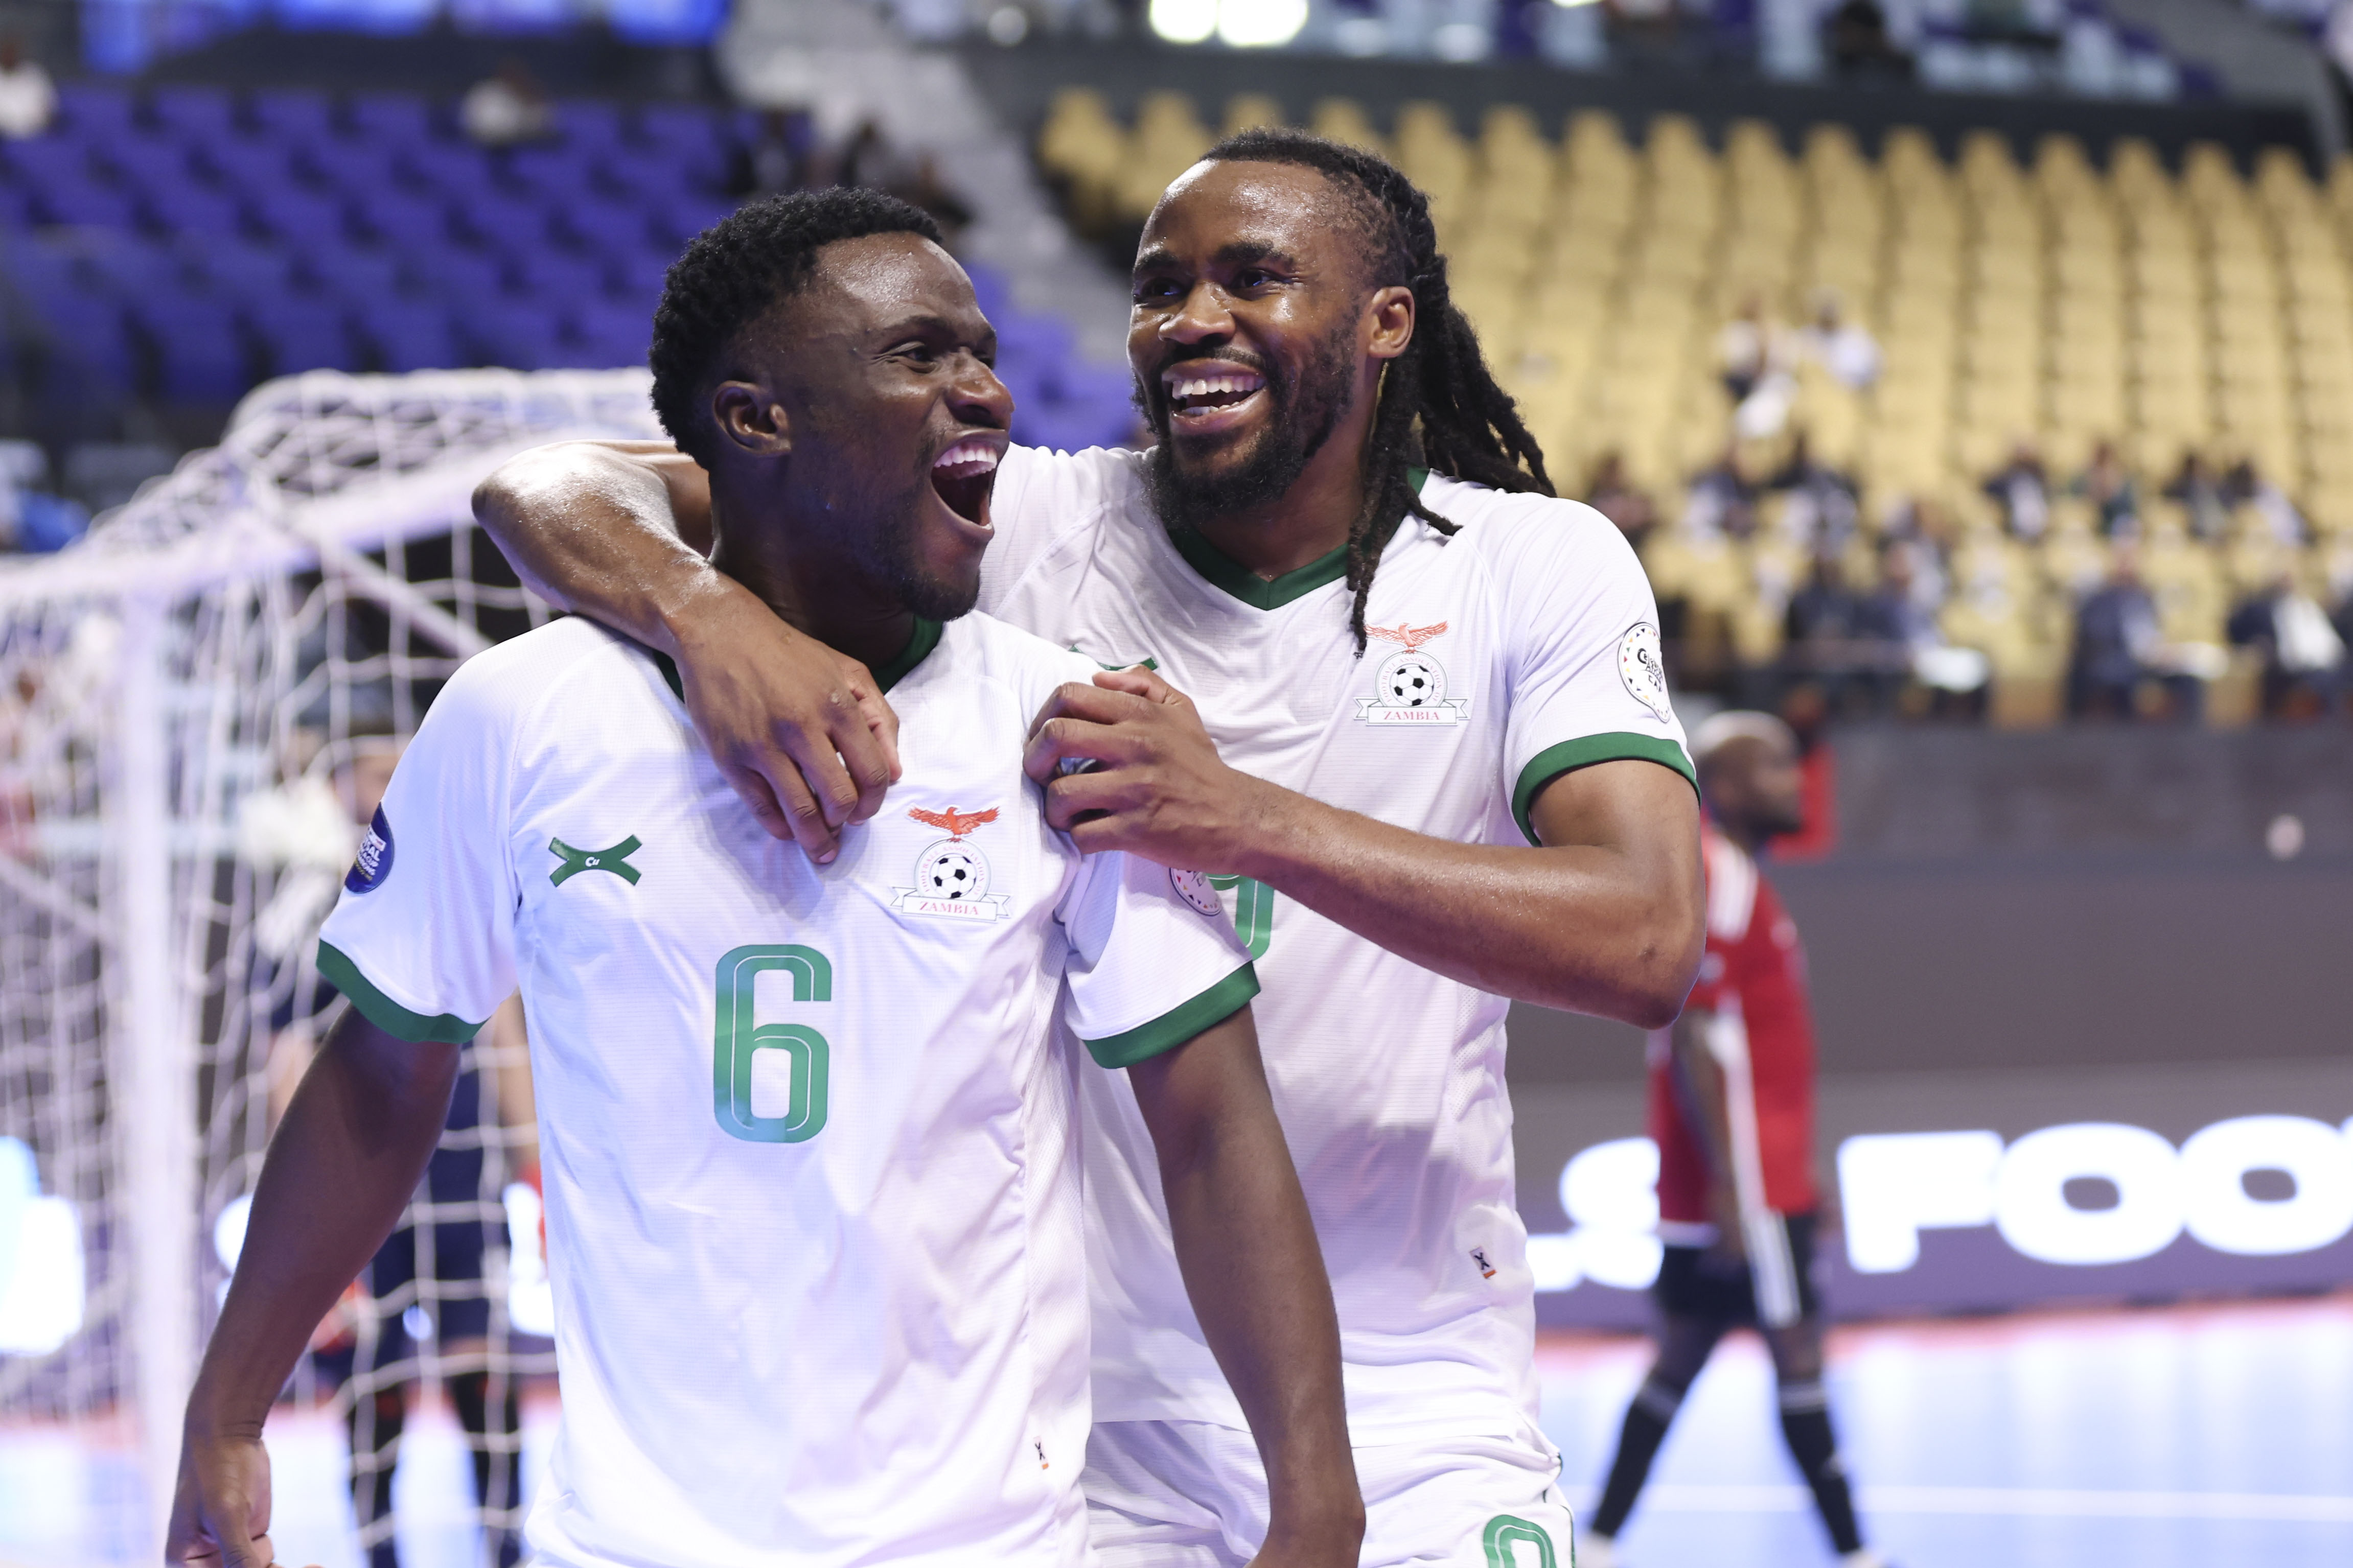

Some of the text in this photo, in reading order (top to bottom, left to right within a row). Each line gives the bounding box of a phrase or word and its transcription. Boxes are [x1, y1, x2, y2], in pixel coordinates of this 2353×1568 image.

[1383, 711, 1440, 720] ZAMBIA
[919, 901, 979, 915] ZAMBIA
[713, 944, 832, 1143] 6
[1836, 1114, 2353, 1274] FOO
